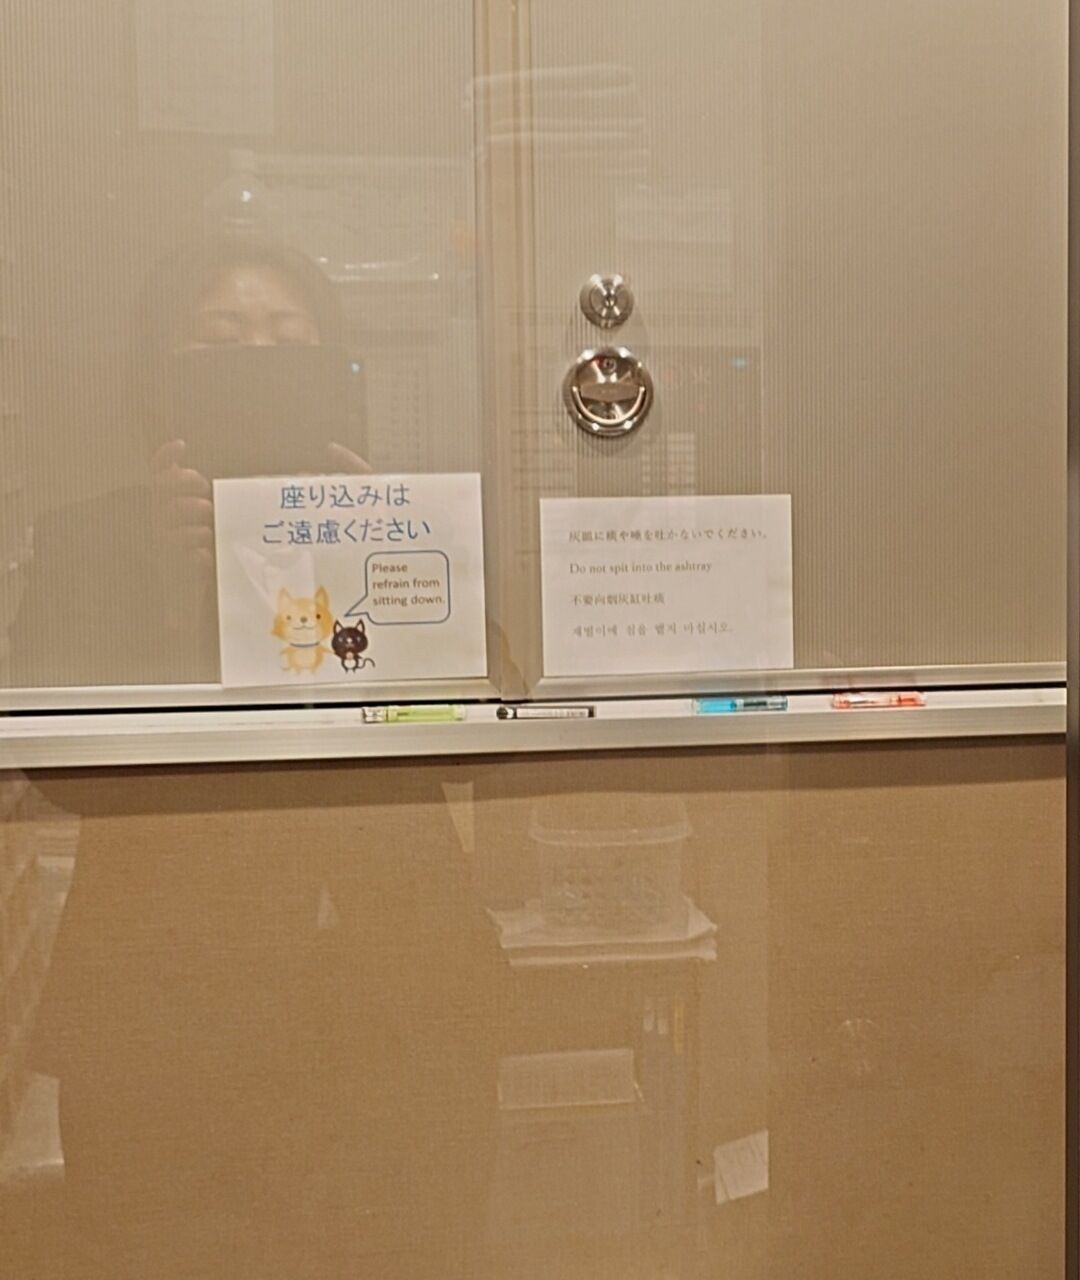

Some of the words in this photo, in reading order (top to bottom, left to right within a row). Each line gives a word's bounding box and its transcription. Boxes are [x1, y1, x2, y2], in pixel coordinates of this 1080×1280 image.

[280, 483, 411, 510] 座り込みは
[262, 518, 431, 546] ご遠慮ください
[372, 563, 408, 573] Please
[569, 563, 586, 574] Do
[589, 564, 607, 574] not
[610, 563, 629, 576] spit
[631, 562, 653, 574] into
[655, 561, 673, 572] the
[674, 560, 712, 574] ashtray
[372, 578, 410, 589] refrain
[413, 577, 440, 588] from
[373, 594, 408, 606] sitting
[411, 593, 446, 604] down.
